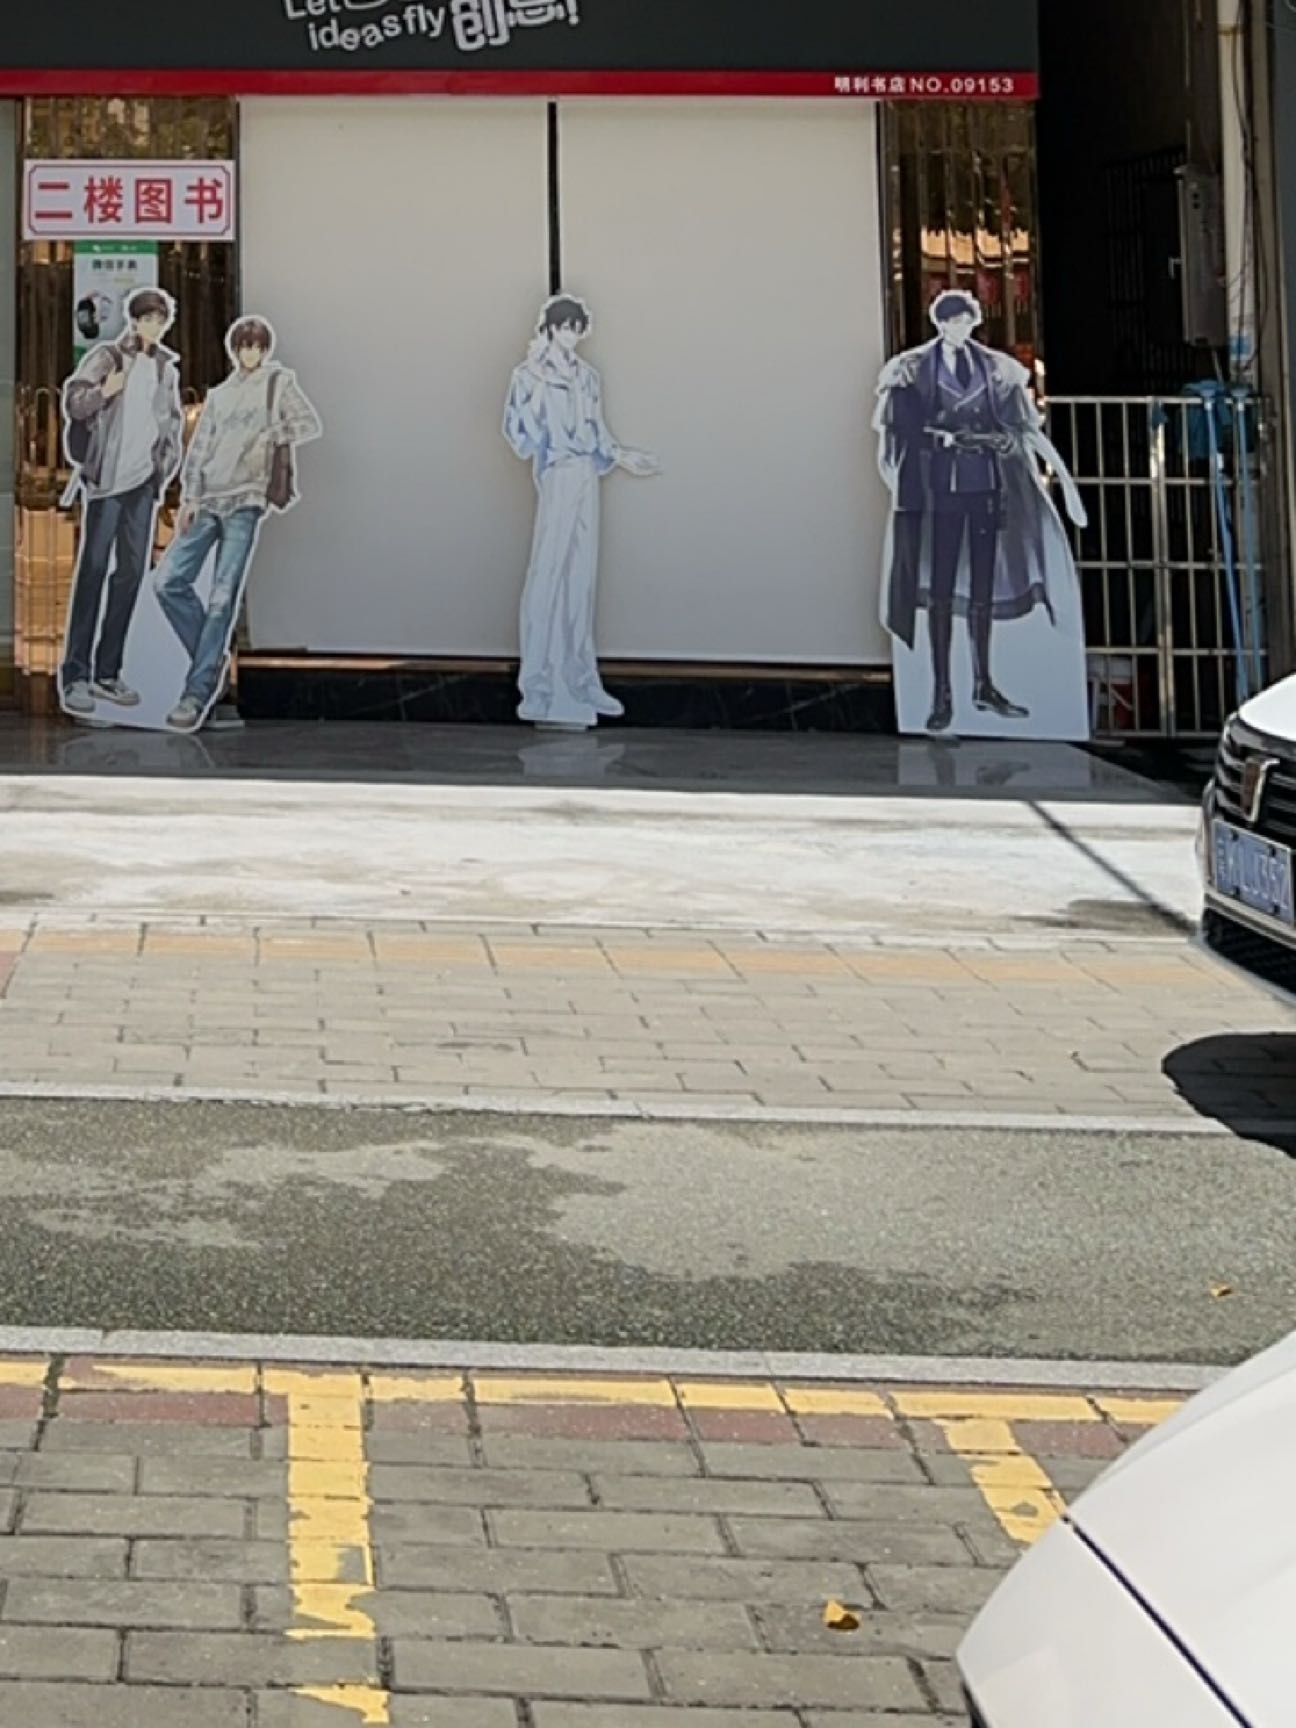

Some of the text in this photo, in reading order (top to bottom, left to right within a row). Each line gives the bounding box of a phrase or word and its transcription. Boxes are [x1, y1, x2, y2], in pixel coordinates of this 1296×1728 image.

[308, 13, 403, 52] ideas
[402, 2, 446, 39] fly
[34, 174, 224, 224] 二楼图书
